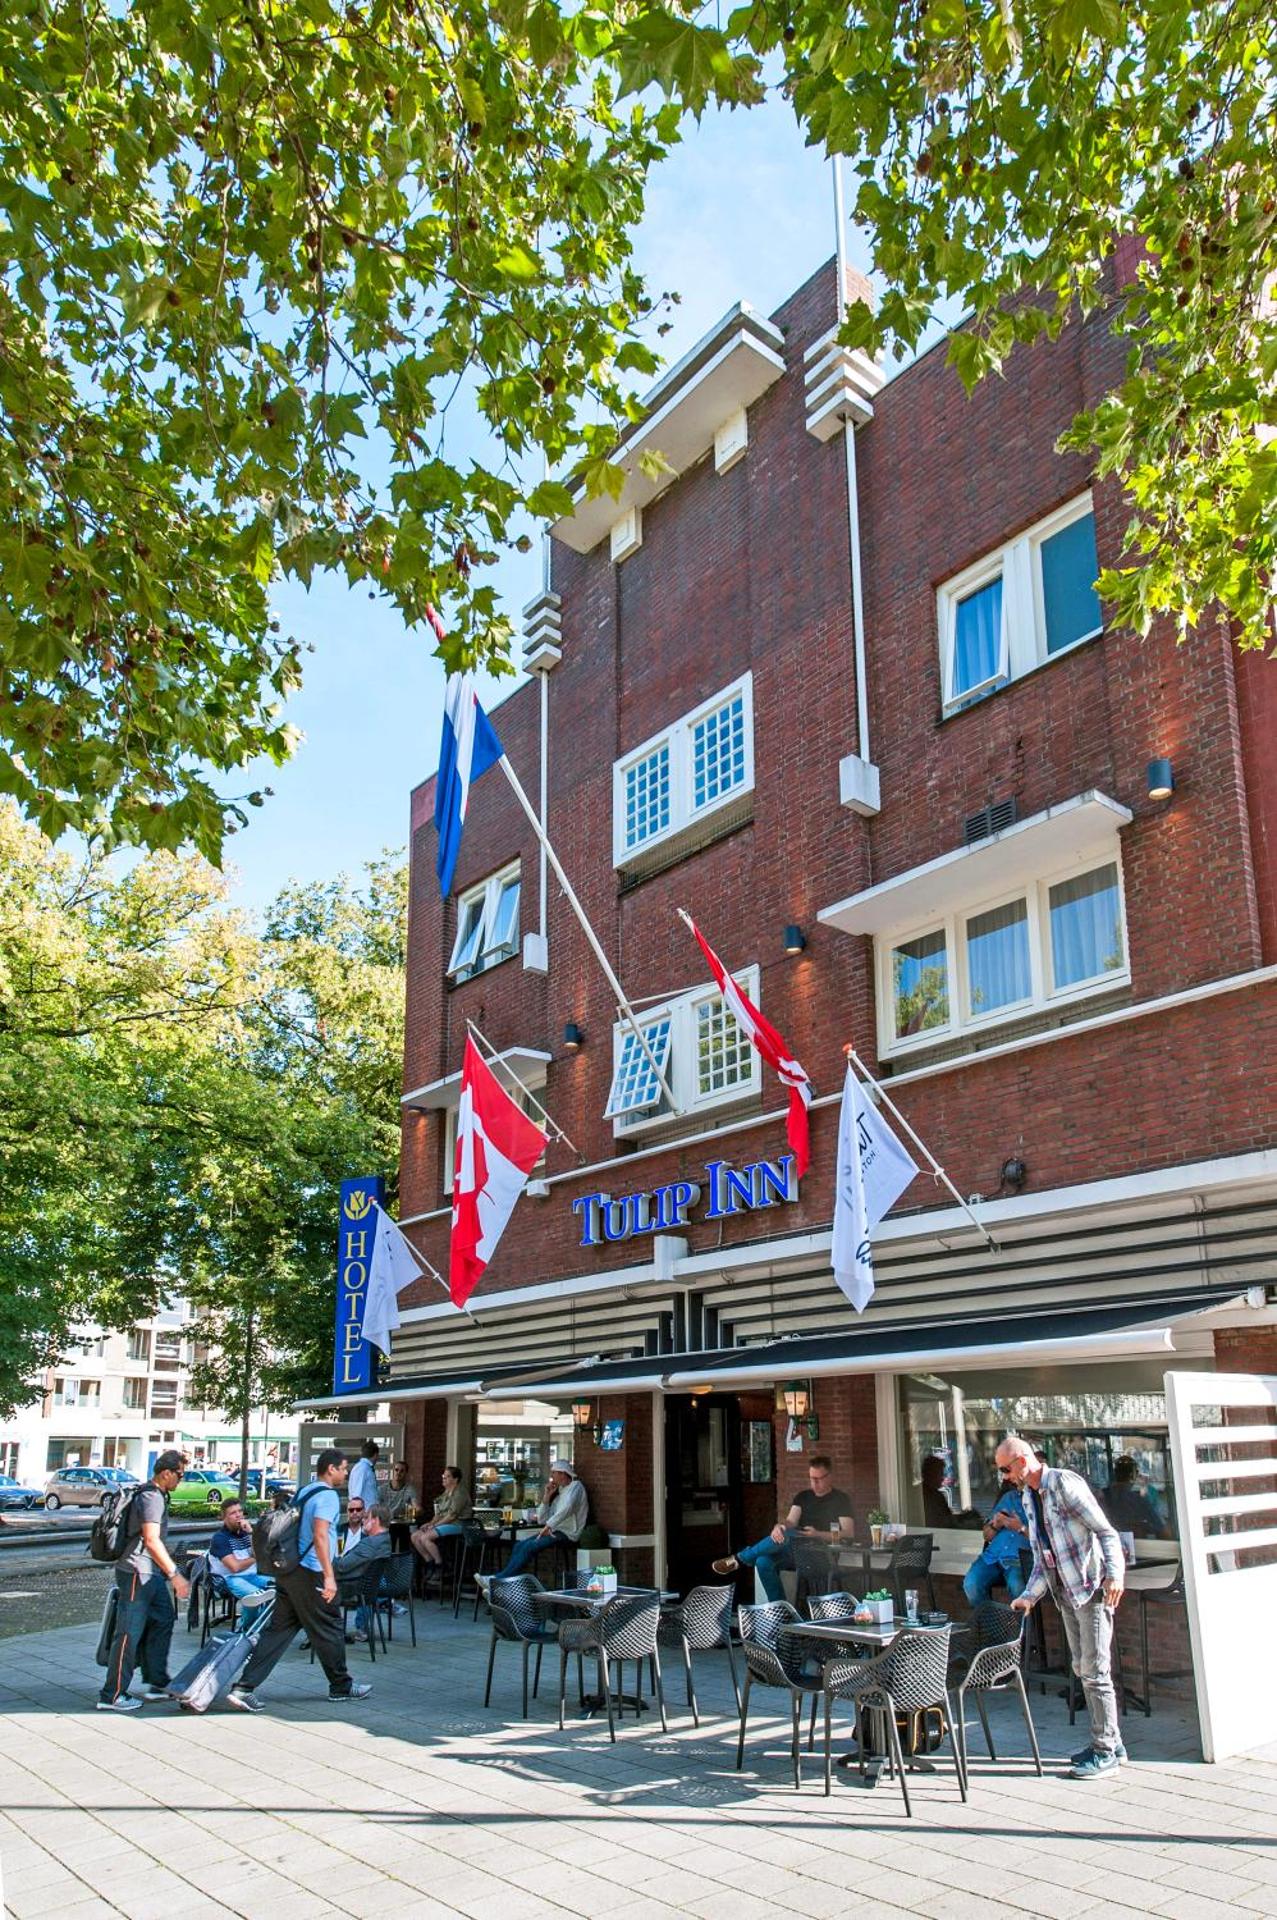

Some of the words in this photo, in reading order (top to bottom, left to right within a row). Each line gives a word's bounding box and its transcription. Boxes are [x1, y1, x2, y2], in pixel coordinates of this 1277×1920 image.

[572, 1182, 697, 1246] TULIP
[705, 1154, 797, 1219] INN
[341, 1230, 368, 1384] HOTEL
